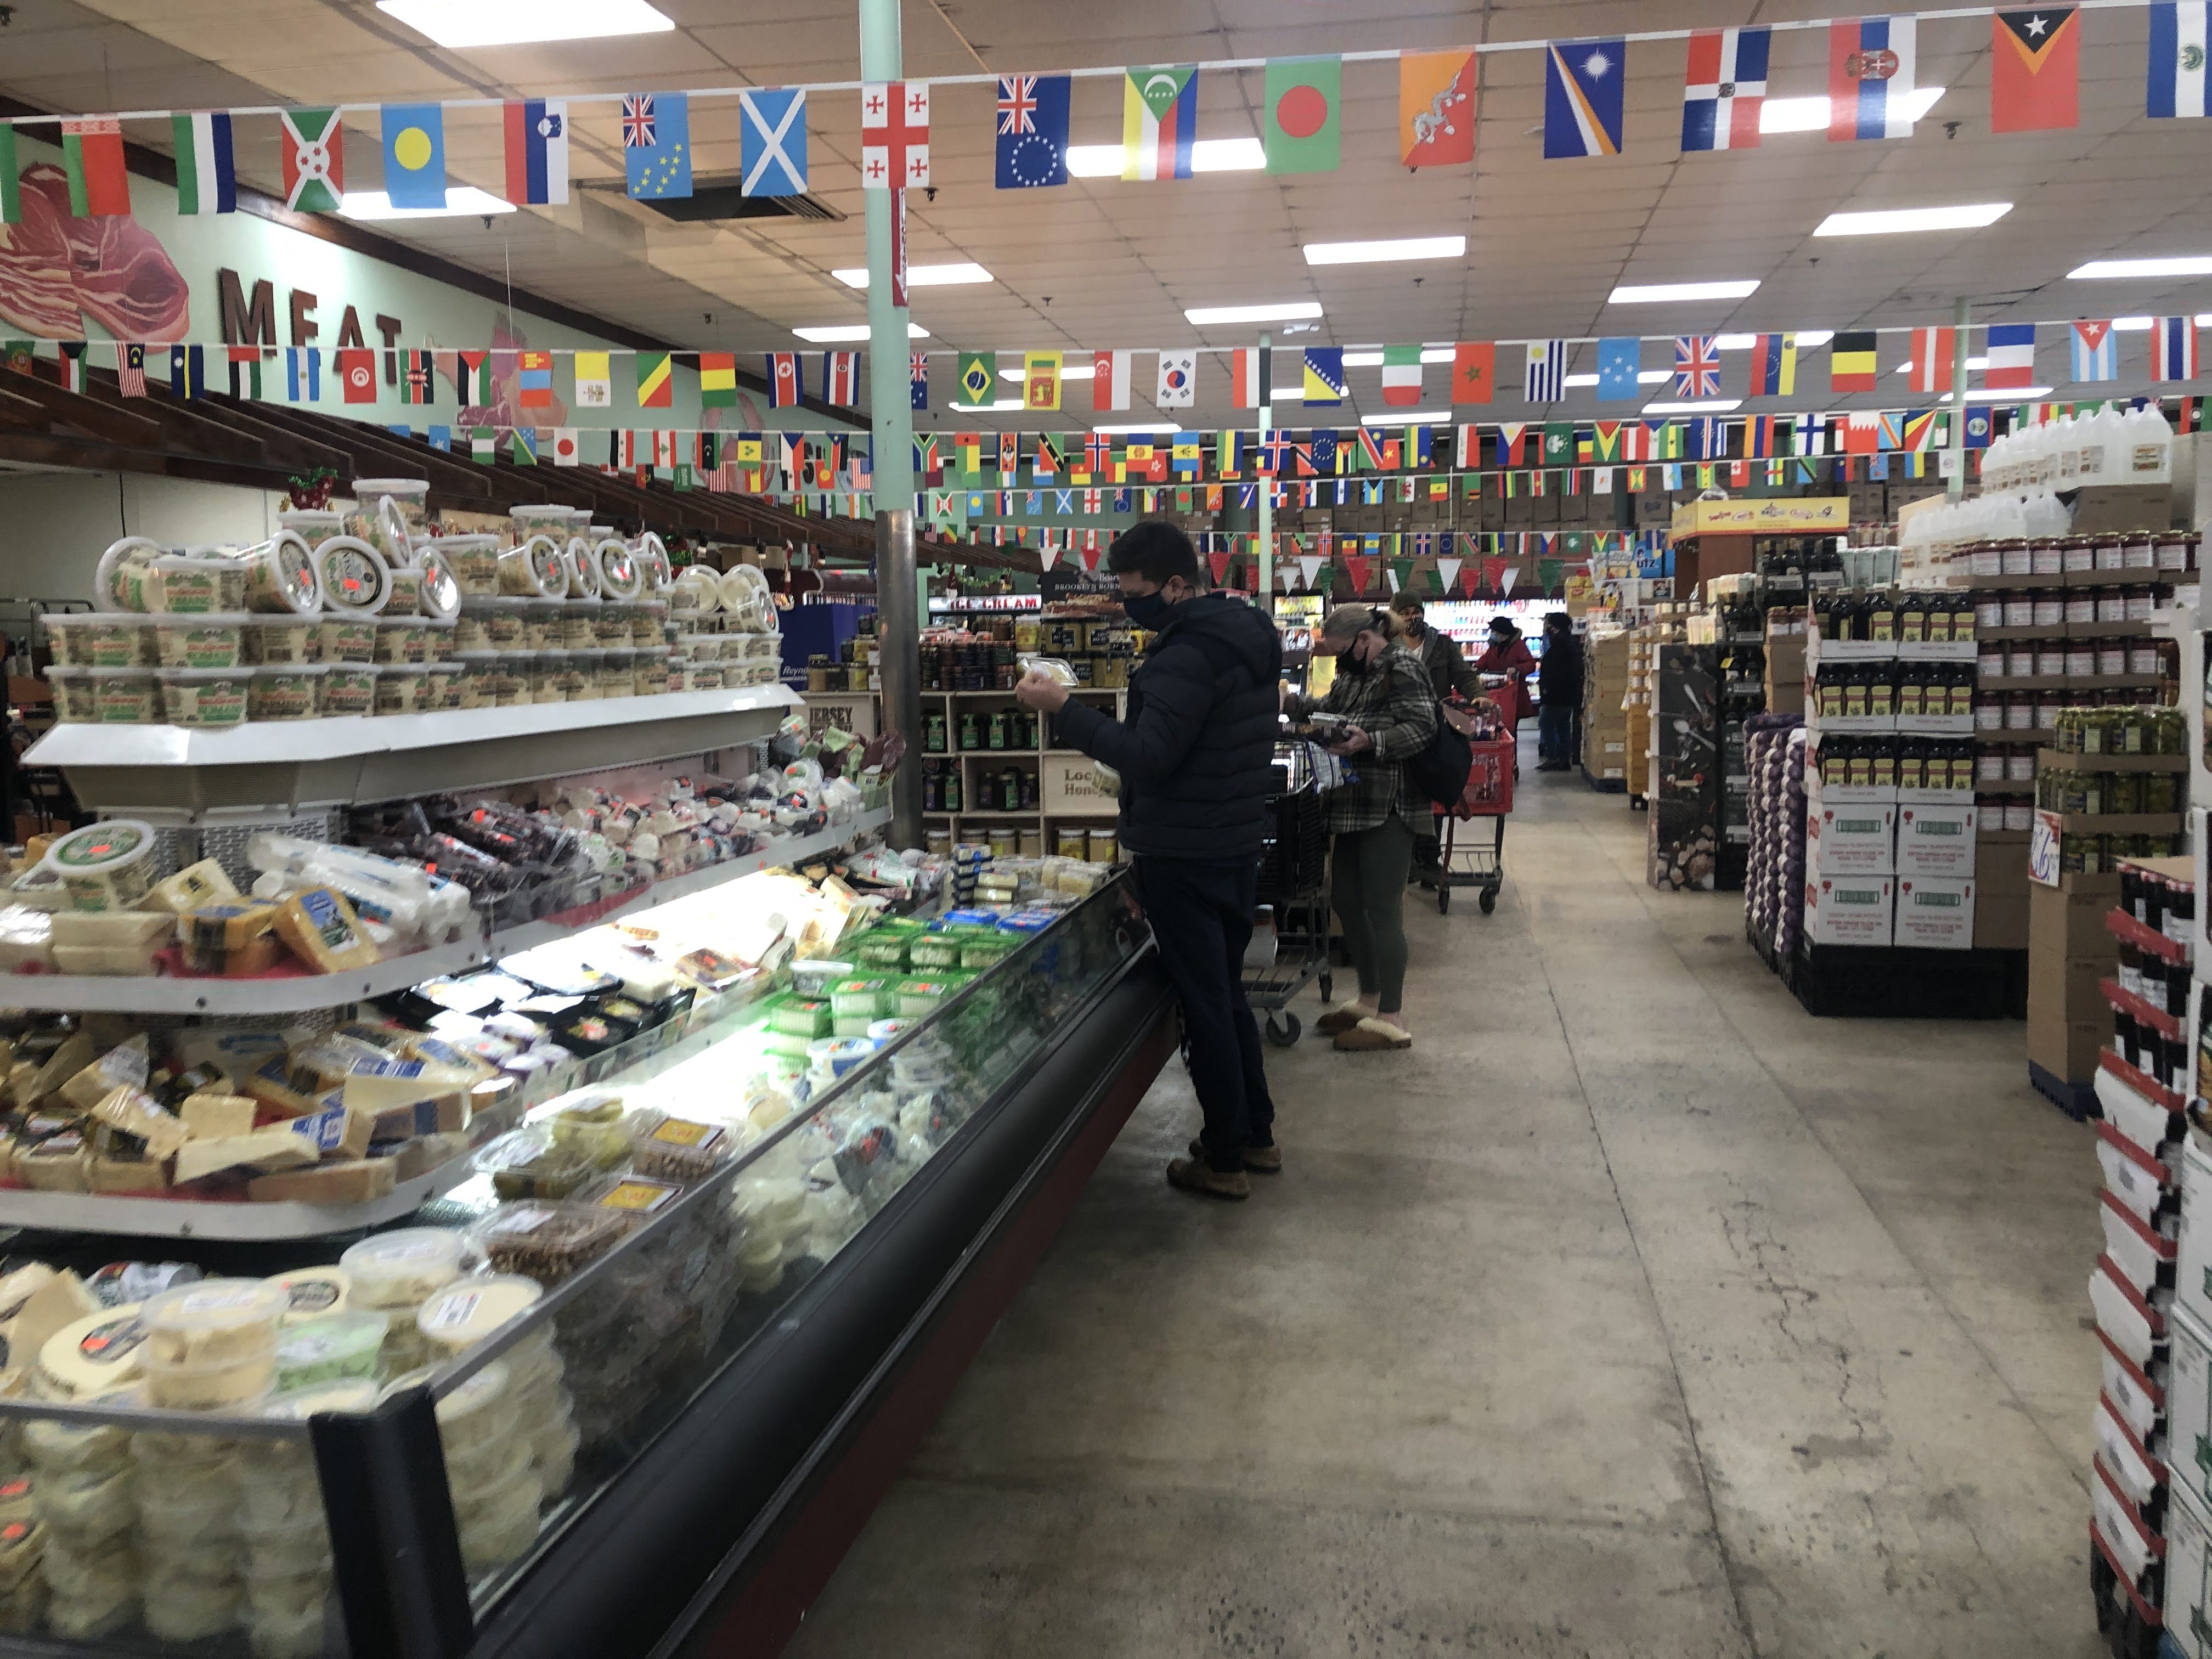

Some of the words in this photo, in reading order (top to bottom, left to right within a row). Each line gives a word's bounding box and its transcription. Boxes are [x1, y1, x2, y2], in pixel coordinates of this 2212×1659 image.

[217, 267, 402, 385] MEAT
[950, 596, 976, 610] ICE
[981, 595, 1037, 610] CREAM
